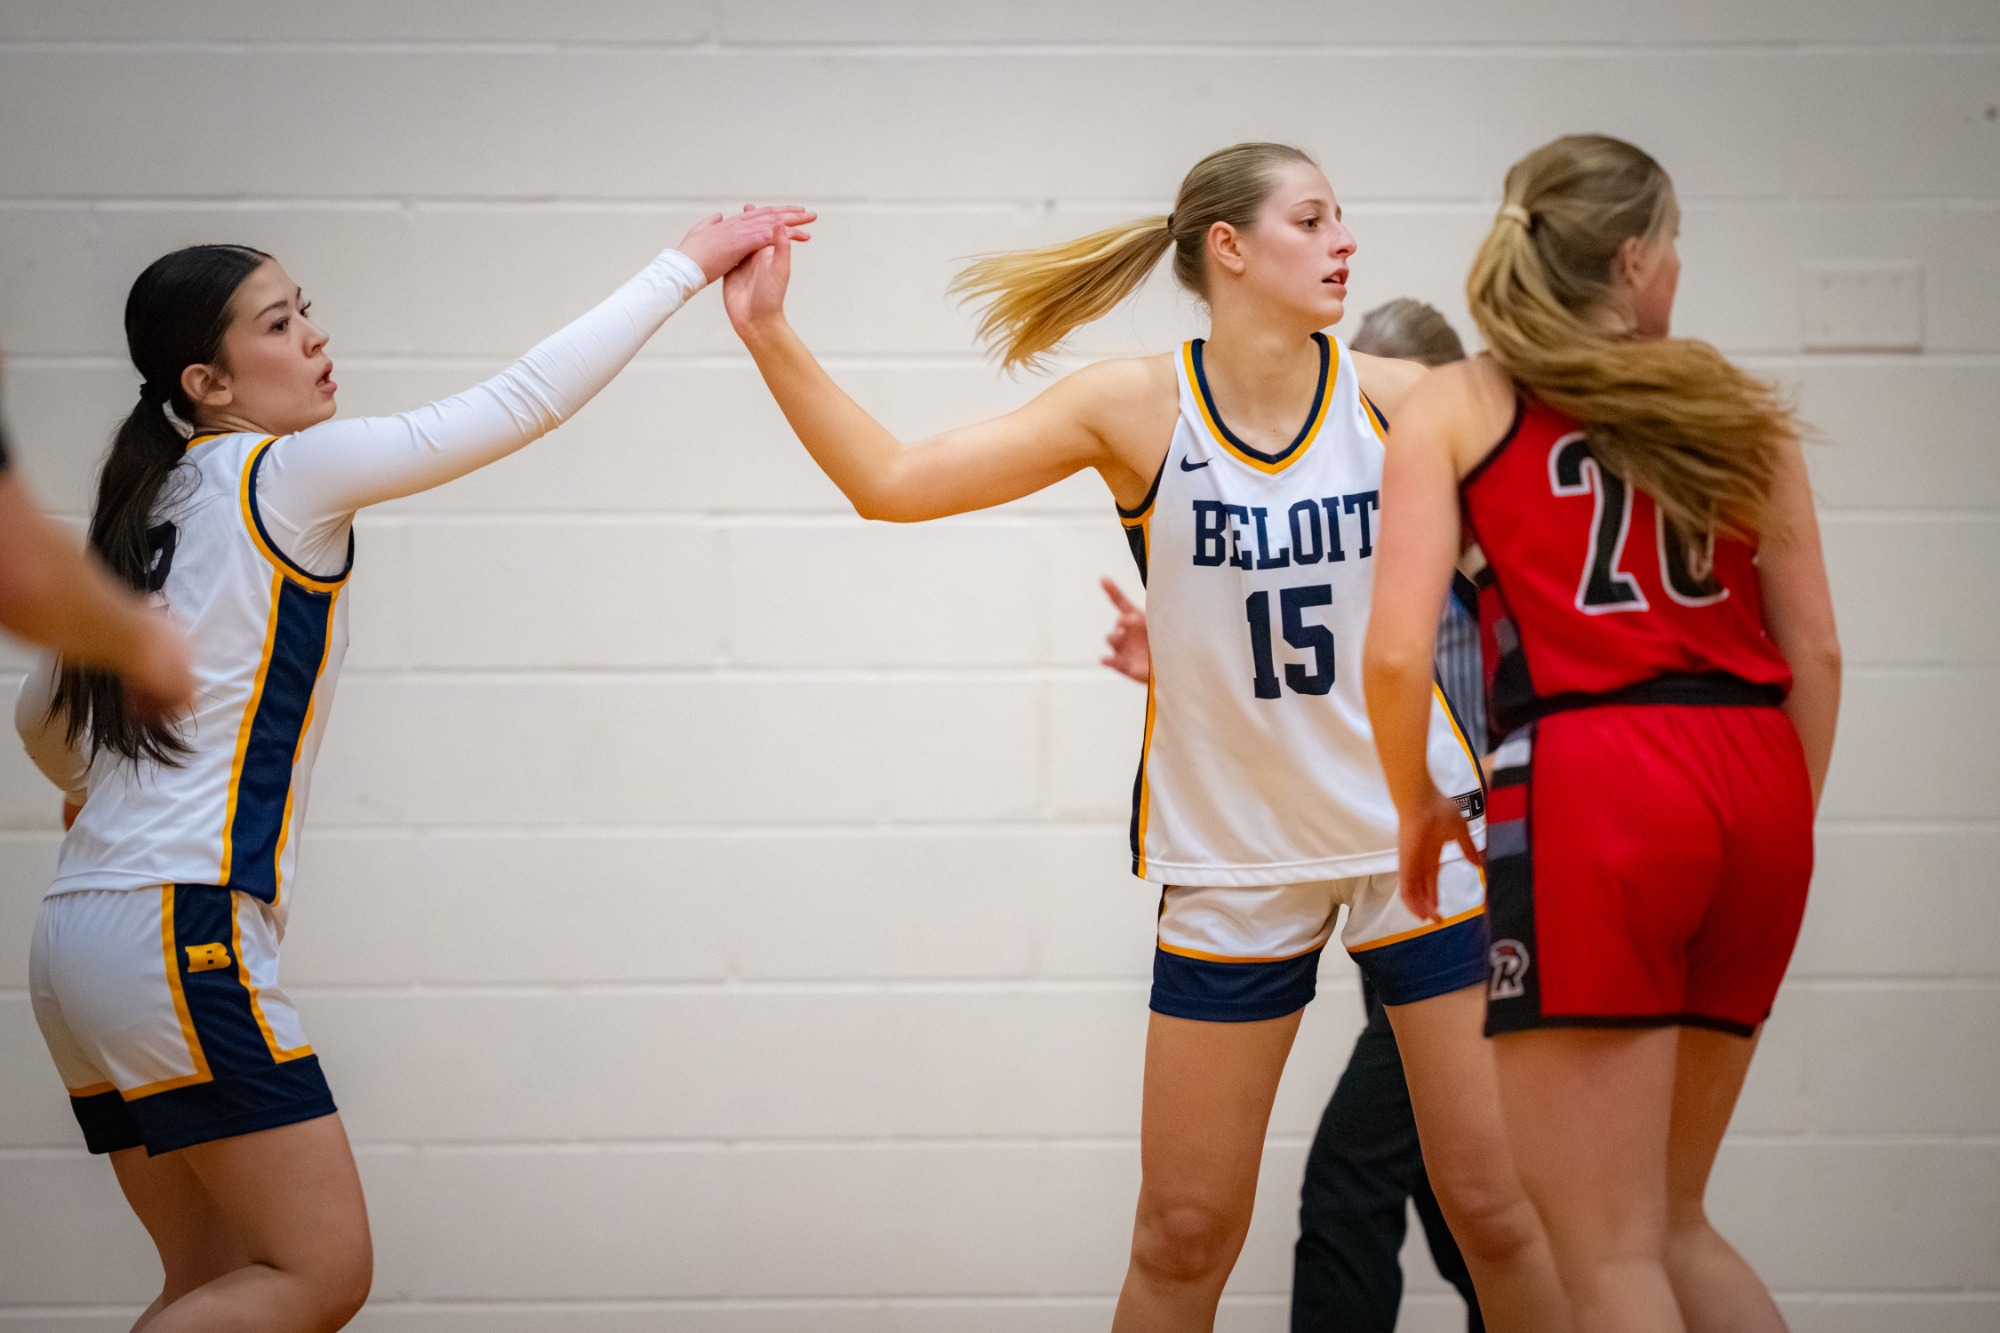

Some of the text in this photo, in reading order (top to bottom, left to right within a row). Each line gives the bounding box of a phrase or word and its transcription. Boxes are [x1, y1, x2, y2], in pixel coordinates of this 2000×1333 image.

[1193, 490, 1379, 570] BELOIT
[1246, 584, 1335, 699] 15
[185, 942, 231, 973] B
